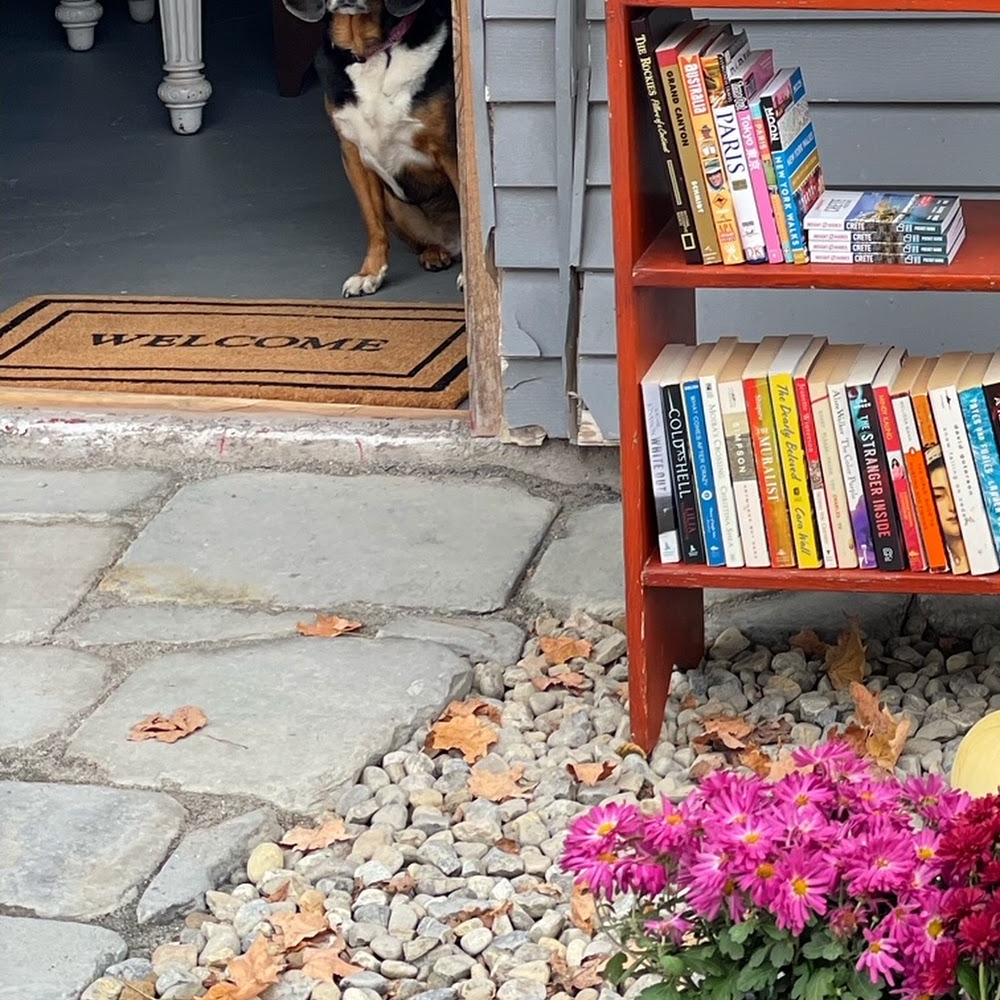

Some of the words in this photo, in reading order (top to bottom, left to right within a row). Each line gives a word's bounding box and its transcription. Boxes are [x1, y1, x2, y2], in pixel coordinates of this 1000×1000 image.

[634, 33, 648, 55] THE
[640, 57, 657, 96] ROCKIES
[666, 70, 680, 104] GRAND
[674, 107, 689, 147] CANYON
[741, 114, 754, 146] Tokyo
[754, 123, 767, 149] PARIS
[763, 107, 780, 141] MOON
[716, 112, 745, 174] PARIS
[775, 156, 786, 179] NEW
[780, 181, 792, 209] YORK
[785, 212, 799, 247] WALKS
[846, 221, 866, 231] CRETE
[853, 233, 872, 241] CRETE
[853, 243, 871, 252] CRETE
[855, 254, 874, 263] CRETE
[91, 333, 389, 352] WELCOME
[689, 394, 697, 414] WHAT
[776, 382, 789, 401] The
[796, 381, 810, 411] Jeanette
[831, 389, 842, 410] Alice
[877, 393, 888, 415] MINDY
[668, 408, 684, 448] COLD
[692, 415, 701, 440] COMES
[775, 402, 795, 438] Dearly
[801, 412, 815, 453] Winterson
[835, 409, 847, 434] Walker
[859, 414, 869, 430] THE
[882, 416, 893, 440] KALING
[696, 441, 704, 464] AFTER
[731, 421, 746, 473] SIMPSON
[840, 437, 850, 453] The
[758, 435, 780, 502] MURALIST
[784, 440, 801, 482] Beloved
[843, 453, 853, 474] Color
[861, 433, 883, 496] STRANGER
[952, 424, 963, 449] david
[958, 453, 974, 495] guterson
[675, 462, 691, 498] HELL
[846, 476, 858, 499] Purple
[794, 506, 807, 531] Cara
[872, 498, 890, 538] INSIDE
[797, 531, 811, 556] Wall
